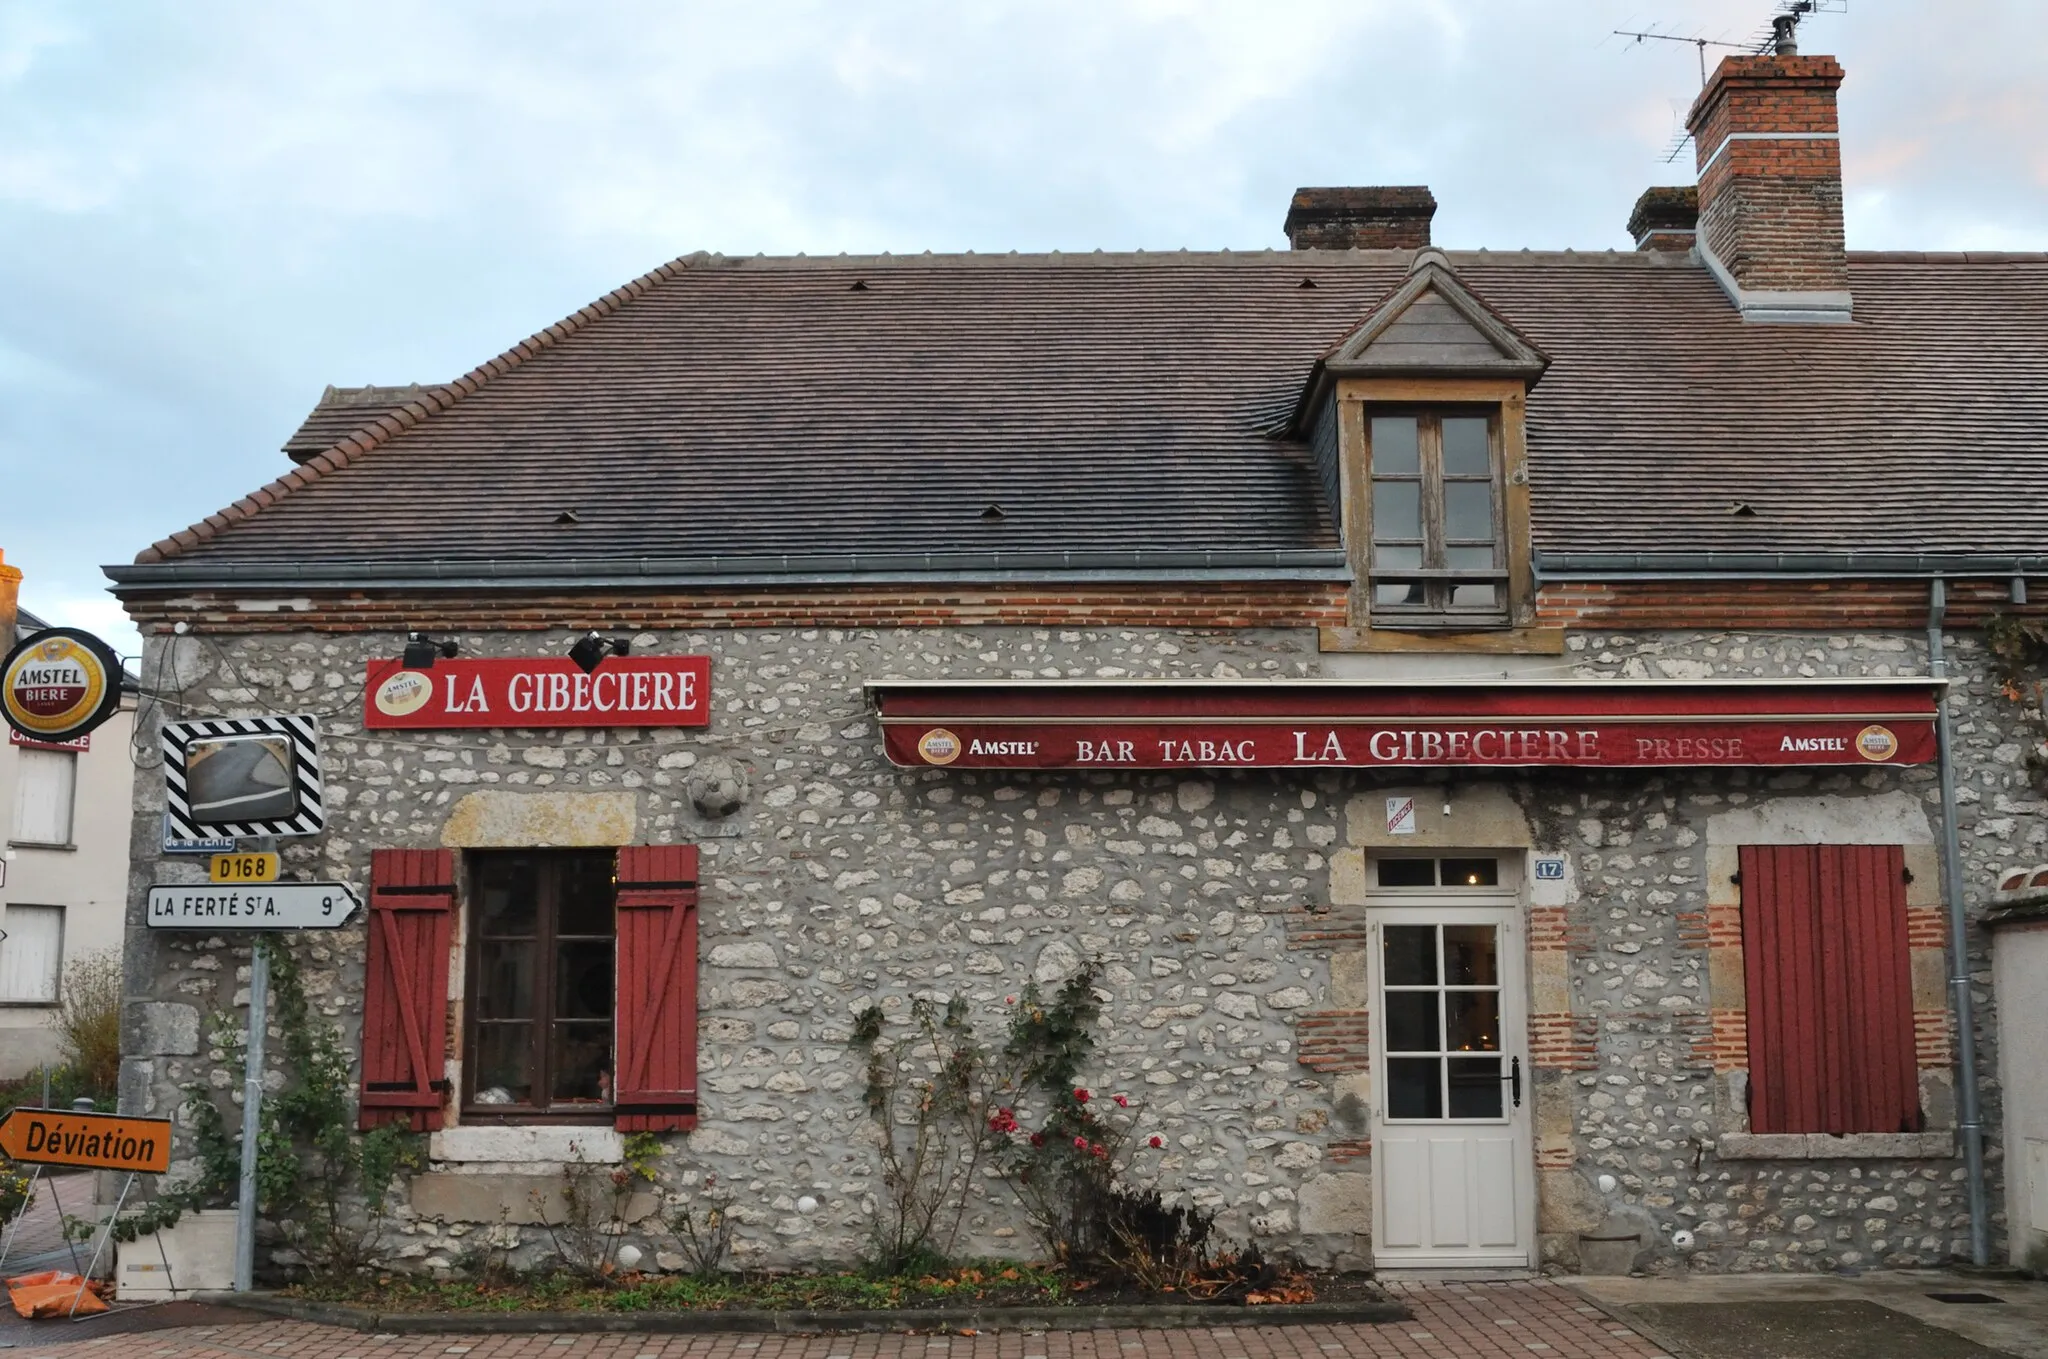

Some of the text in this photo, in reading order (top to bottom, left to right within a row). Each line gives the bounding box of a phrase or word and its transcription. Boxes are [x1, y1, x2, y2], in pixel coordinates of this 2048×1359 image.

[18, 669, 82, 685] AMSTEL
[386, 679, 418, 693] AMSTEL
[26, 689, 68, 701] BIERE
[444, 671, 697, 713] LA GIBECIERE
[1076, 740, 1136, 762] BAR
[1158, 739, 1255, 762] TABAC
[1293, 730, 1347, 761] LA
[1369, 730, 1600, 761] GIBECIERE
[1636, 738, 1743, 759] PRESSE
[1389, 801, 1412, 831] LICENCE
[220, 858, 265, 878] D 168
[1541, 863, 1558, 876] 17
[154, 897, 174, 916] LA
[183, 893, 238, 916] FERTÉ
[322, 896, 332, 916] 9
[26, 1120, 156, 1162] Déviation
